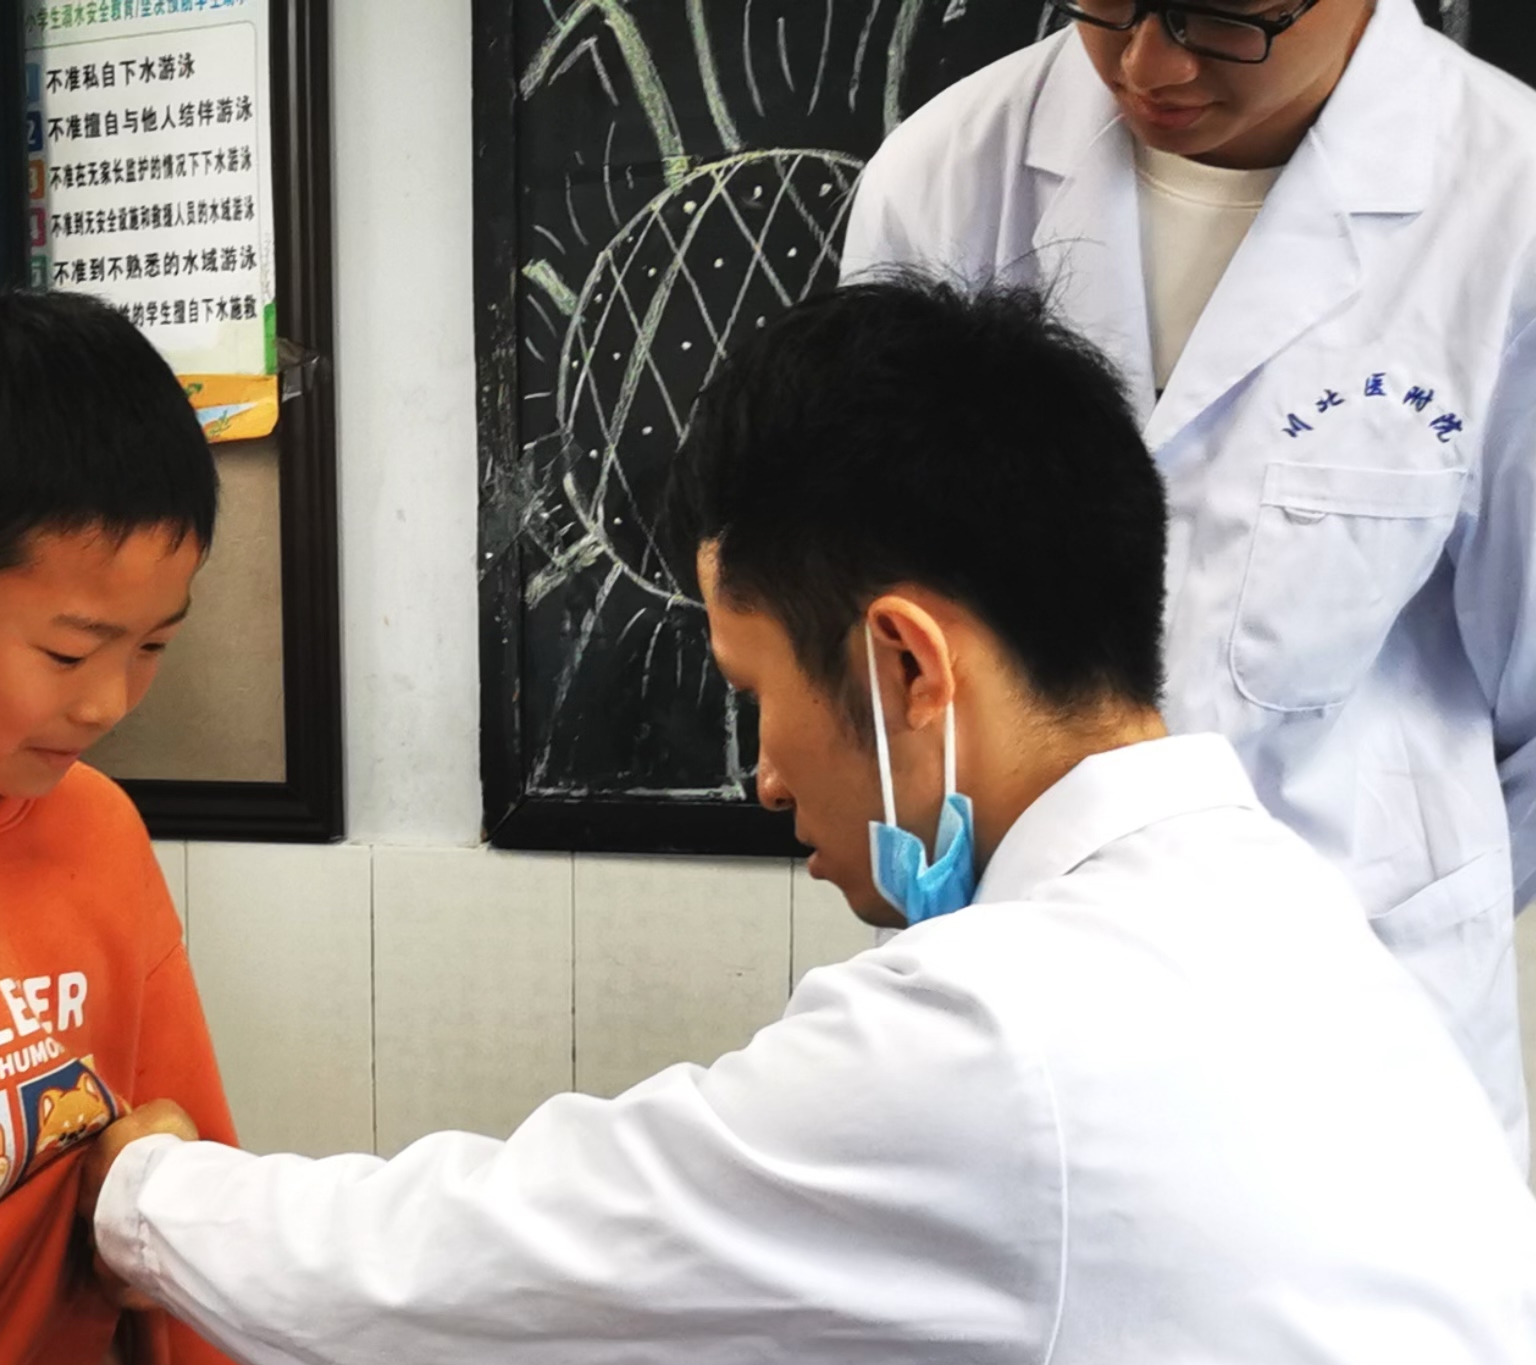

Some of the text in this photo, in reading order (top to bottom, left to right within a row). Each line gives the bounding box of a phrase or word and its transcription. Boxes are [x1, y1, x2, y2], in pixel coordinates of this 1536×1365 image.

[46, 53, 195, 94] 不准私自下水游泳
[48, 96, 253, 142] 不准擅自与他人结伴游泳
[50, 146, 252, 190] 不准在无家长监护的情况下下水游泳
[51, 195, 255, 239] 不准到无安全设施和救援人员的水域游泳
[53, 245, 257, 286] 不准到不熟悉的水域游泳
